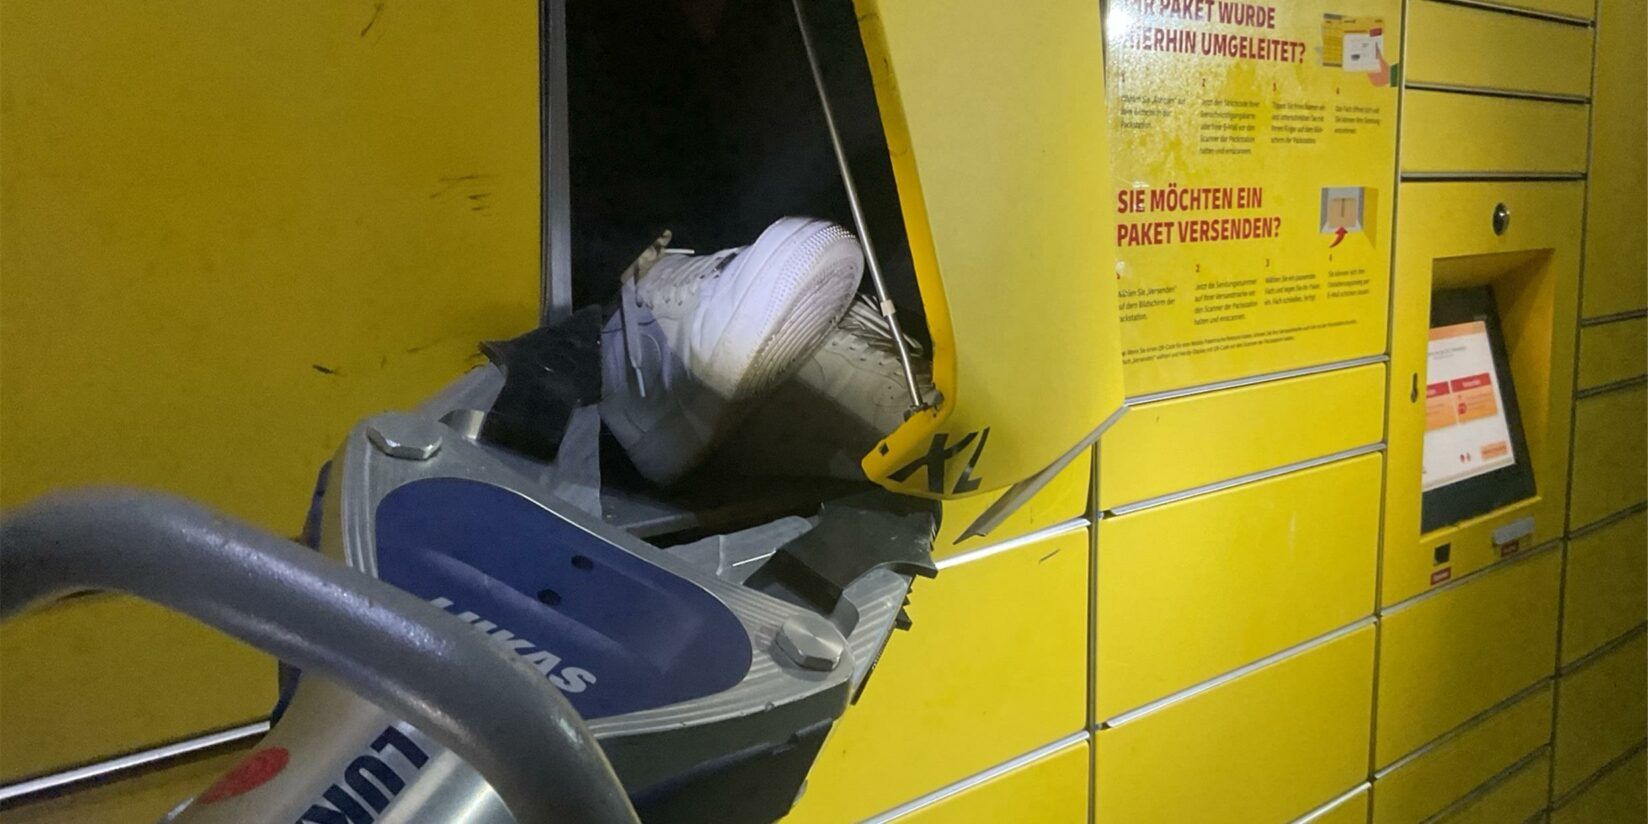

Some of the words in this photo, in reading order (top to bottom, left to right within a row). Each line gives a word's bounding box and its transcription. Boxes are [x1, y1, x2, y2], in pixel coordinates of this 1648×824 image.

[1161, 0, 1214, 22] PAKET
[1218, 0, 1276, 29] WURDE
[1201, 32, 1306, 64] UMGELEITET?
[1117, 189, 1146, 213] SIE
[1150, 182, 1233, 212] MÖCHTEN
[1236, 187, 1262, 209] EIN
[1117, 222, 1175, 247] PAKET
[1177, 216, 1281, 243] VERSENDEN?
[886, 426, 990, 495] XL
